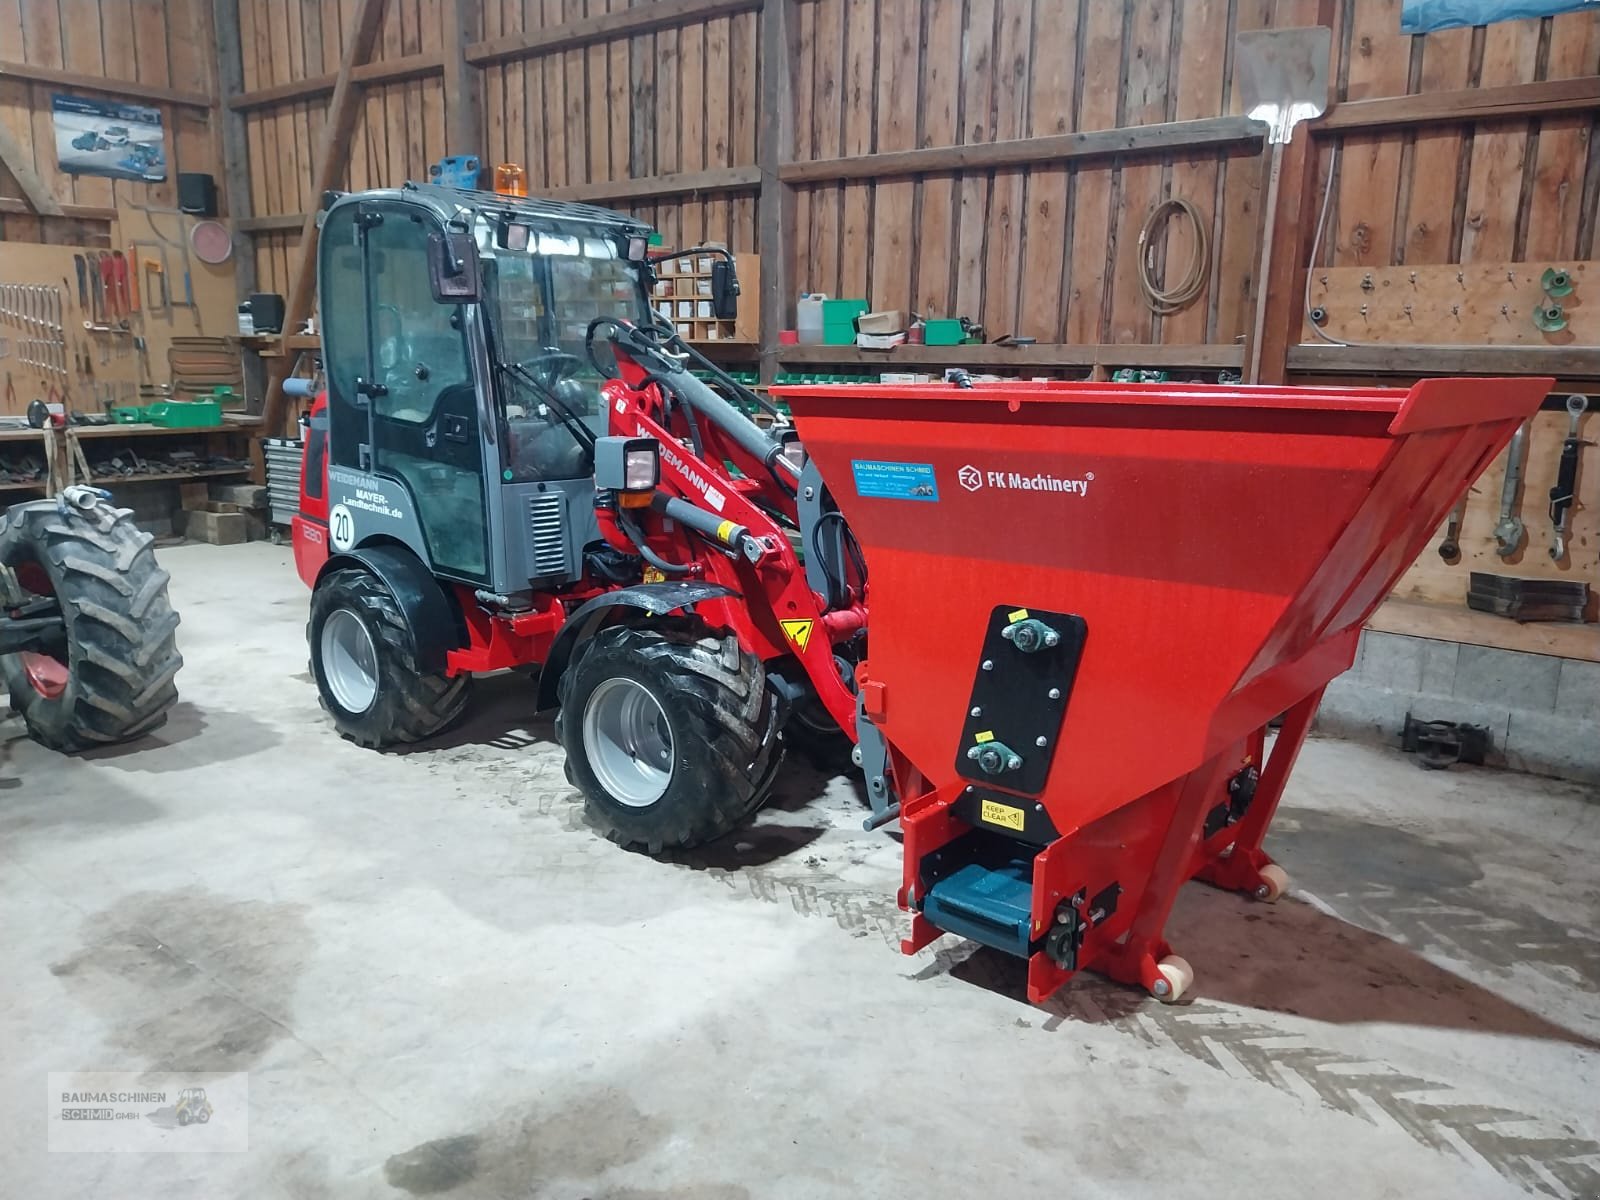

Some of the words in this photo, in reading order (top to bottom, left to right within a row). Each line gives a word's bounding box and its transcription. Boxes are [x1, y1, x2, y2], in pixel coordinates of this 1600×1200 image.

[328, 470, 379, 491] WEIDEMANN
[987, 471, 1006, 488] FK
[355, 489, 388, 505] MAYER-
[343, 495, 403, 518] Landtechnik.de
[335, 513, 349, 543] 20
[983, 811, 1006, 821] CLEAR
[986, 805, 1005, 813] KEEP
